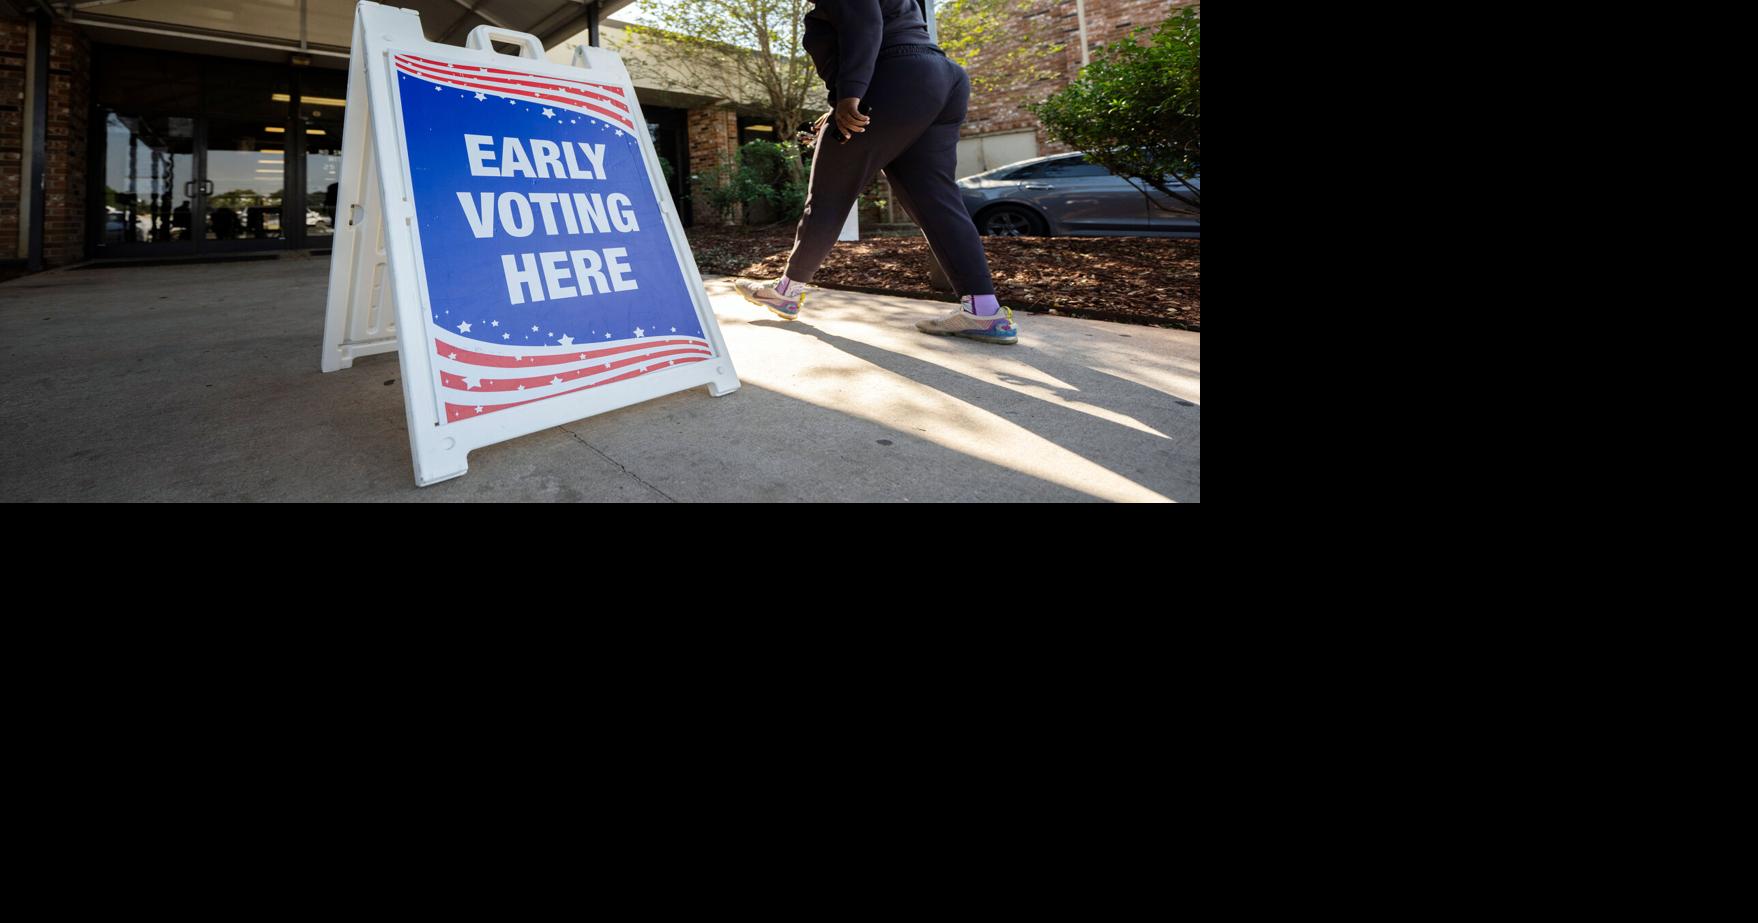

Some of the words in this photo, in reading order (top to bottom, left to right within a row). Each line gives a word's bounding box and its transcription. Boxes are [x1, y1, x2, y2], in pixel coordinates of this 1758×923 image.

[464, 133, 607, 180] EARLY
[456, 191, 640, 239] VOTING
[501, 247, 639, 305] HERE
